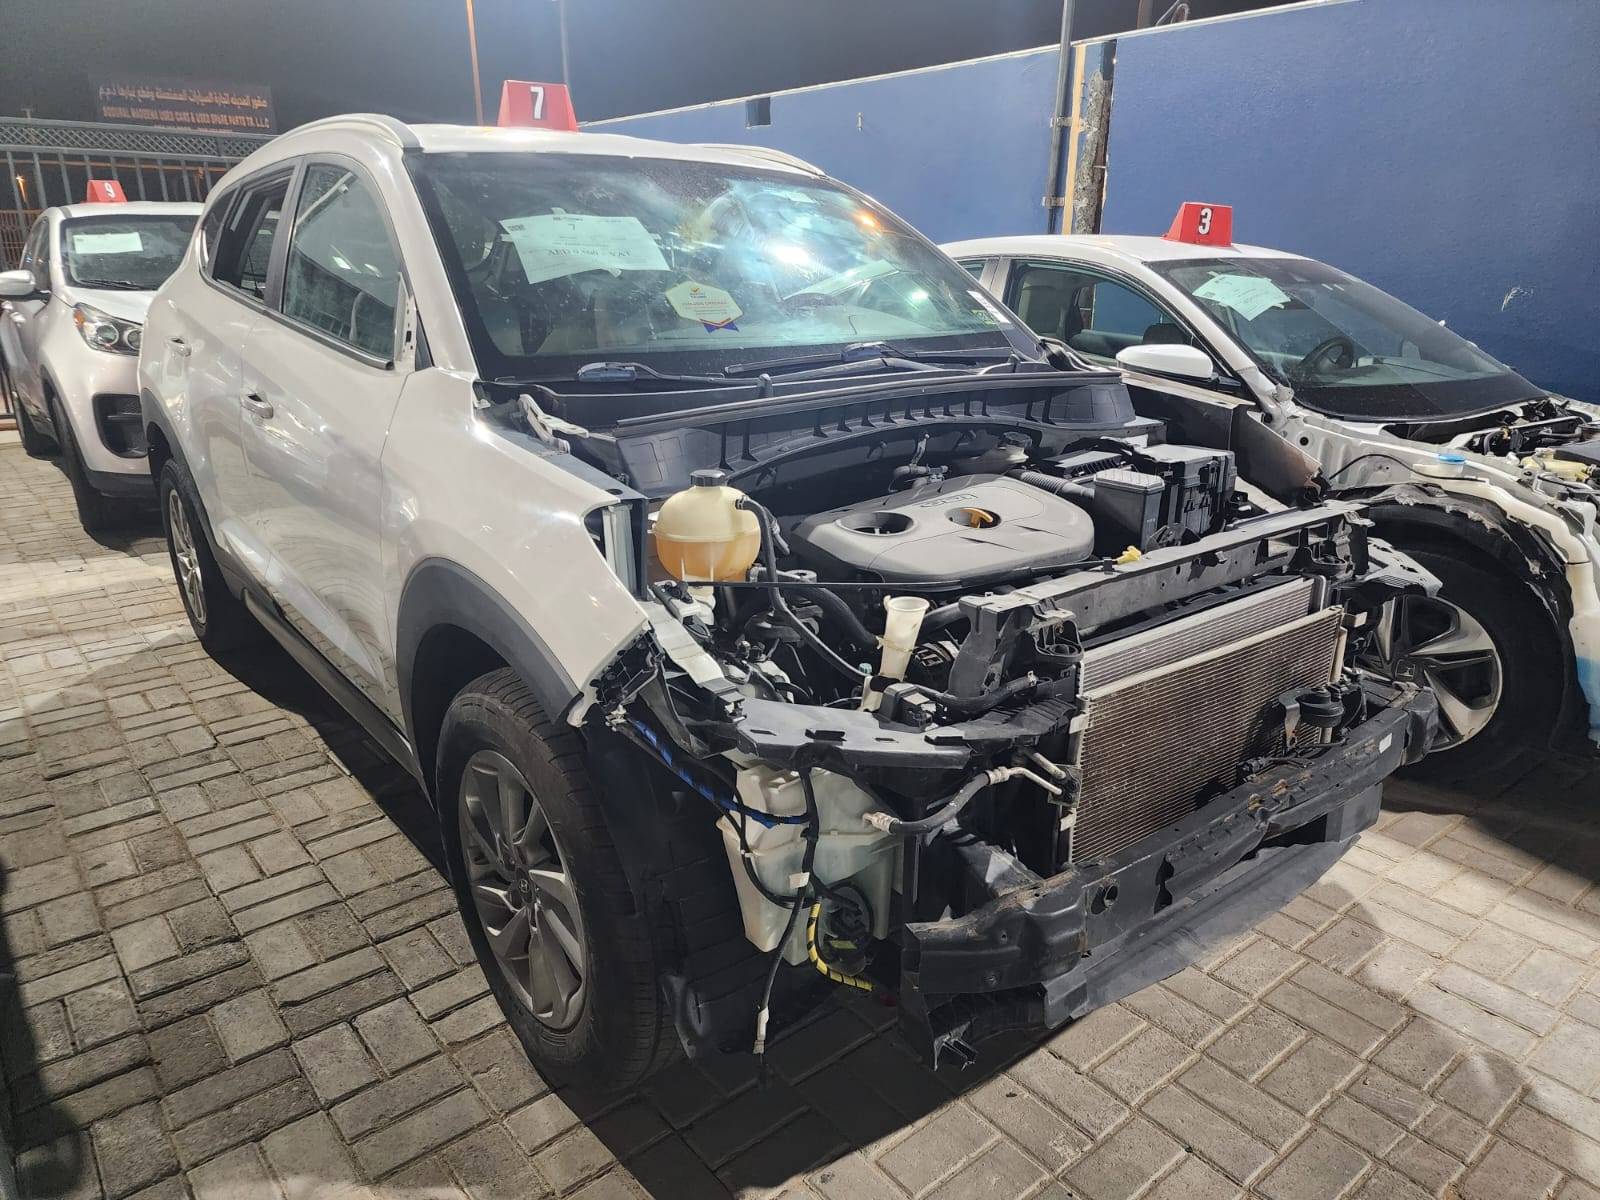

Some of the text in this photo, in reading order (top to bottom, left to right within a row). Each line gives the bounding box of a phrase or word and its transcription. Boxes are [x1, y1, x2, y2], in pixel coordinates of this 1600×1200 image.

[530, 86, 544, 120] 7
[104, 182, 115, 198] 9
[1198, 207, 1213, 235] 3
